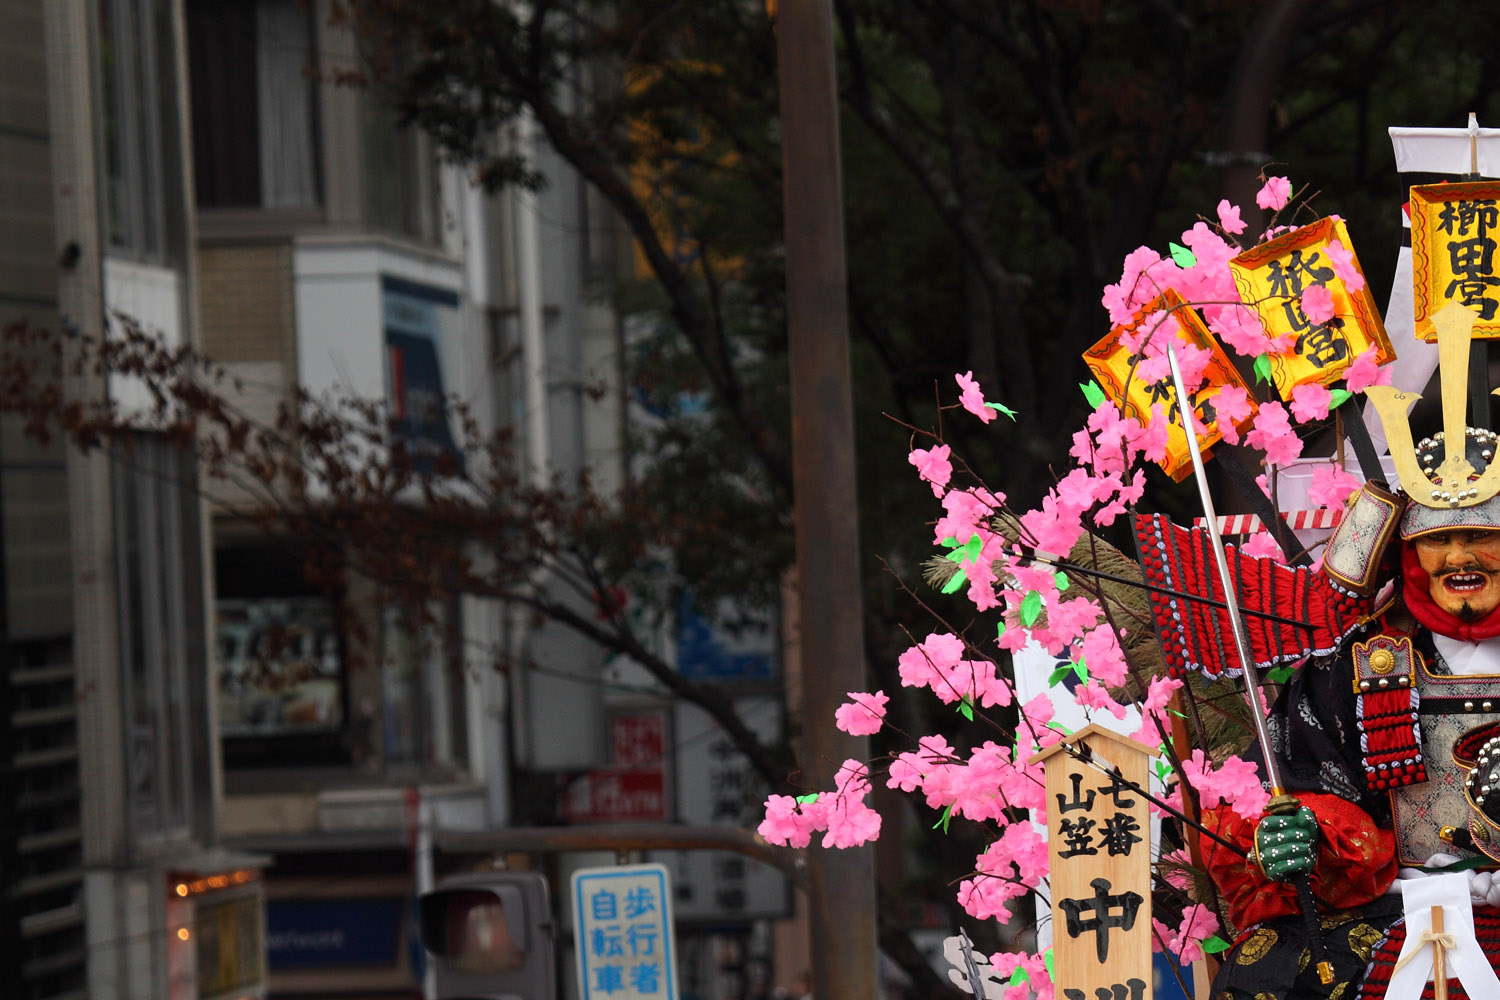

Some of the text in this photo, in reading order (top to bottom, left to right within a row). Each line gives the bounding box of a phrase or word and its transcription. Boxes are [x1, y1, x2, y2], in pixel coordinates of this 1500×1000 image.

[1056, 772, 1099, 860] 山笠
[1098, 776, 1143, 857] 七番
[591, 888, 627, 995] 自転車
[624, 886, 661, 994] 歩行者
